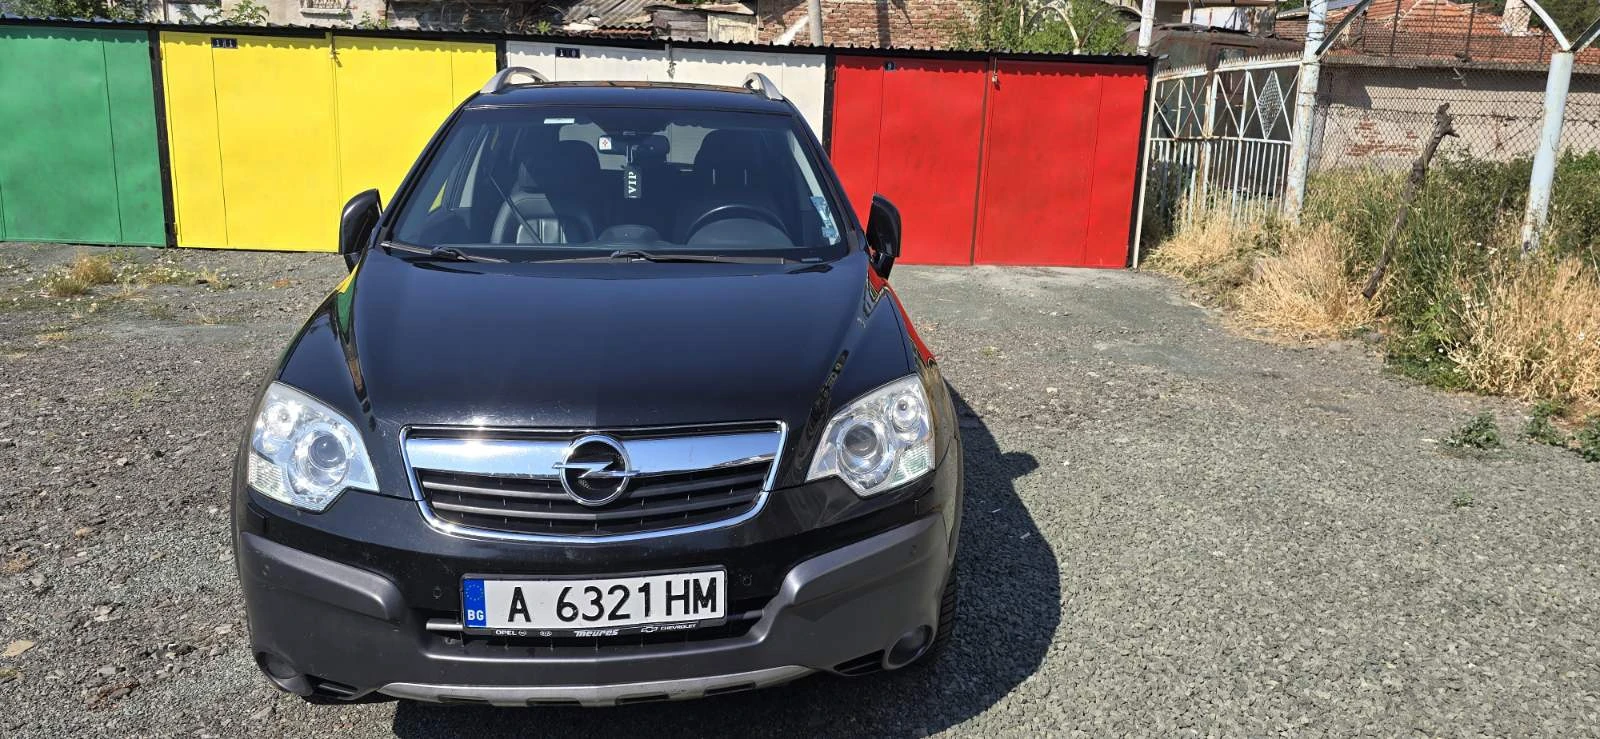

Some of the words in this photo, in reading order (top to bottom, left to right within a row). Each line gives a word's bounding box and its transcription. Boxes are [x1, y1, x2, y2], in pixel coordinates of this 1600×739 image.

[628, 171, 637, 194] VIP
[507, 586, 532, 623] A
[556, 582, 651, 622] 6321
[665, 576, 718, 616] HM
[467, 609, 485, 621] BG
[660, 623, 697, 631] CHEVROLET
